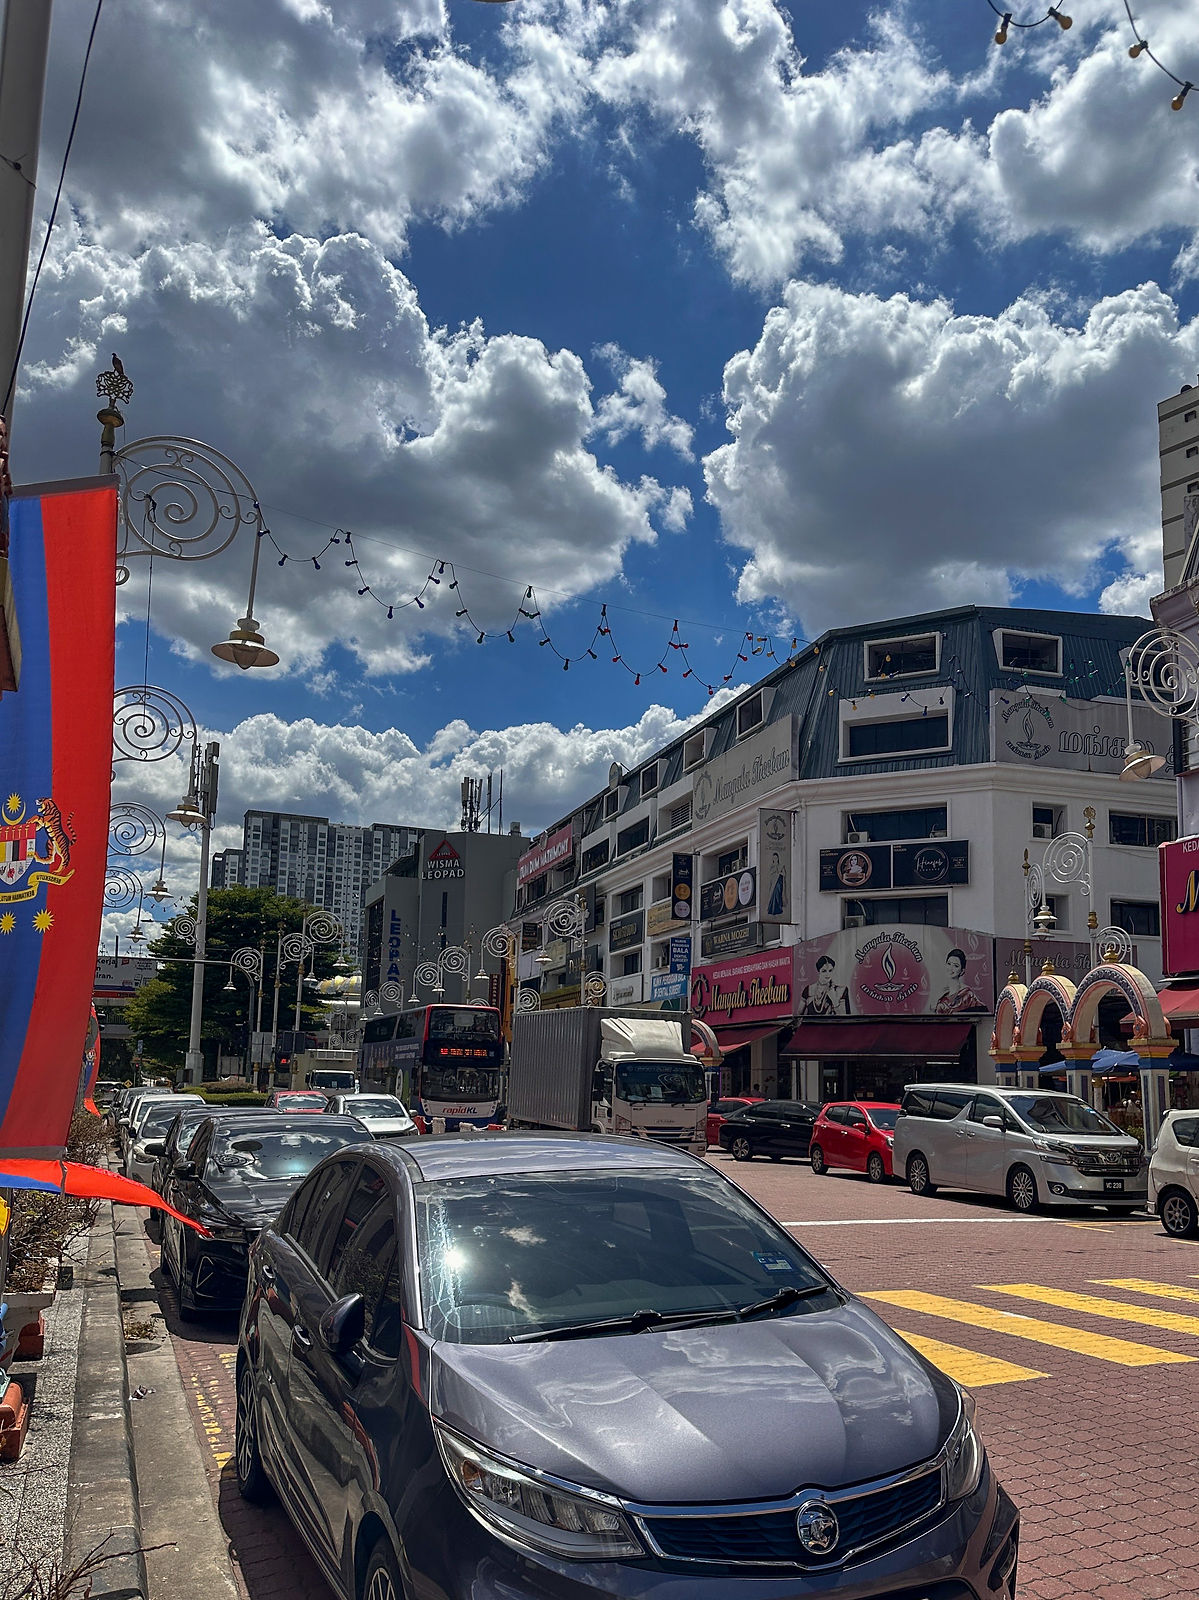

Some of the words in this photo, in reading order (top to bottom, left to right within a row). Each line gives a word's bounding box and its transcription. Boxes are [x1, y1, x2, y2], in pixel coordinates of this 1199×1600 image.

[712, 763, 751, 804] Mangala
[421, 868, 465, 880] LEOPAD
[427, 859, 460, 869] WISMA
[855, 931, 891, 964] Mangala
[891, 932, 923, 962] Theebam
[707, 980, 747, 1018] Mangala
[748, 975, 789, 1006] Theebam
[442, 1105, 478, 1115] rapidKL
